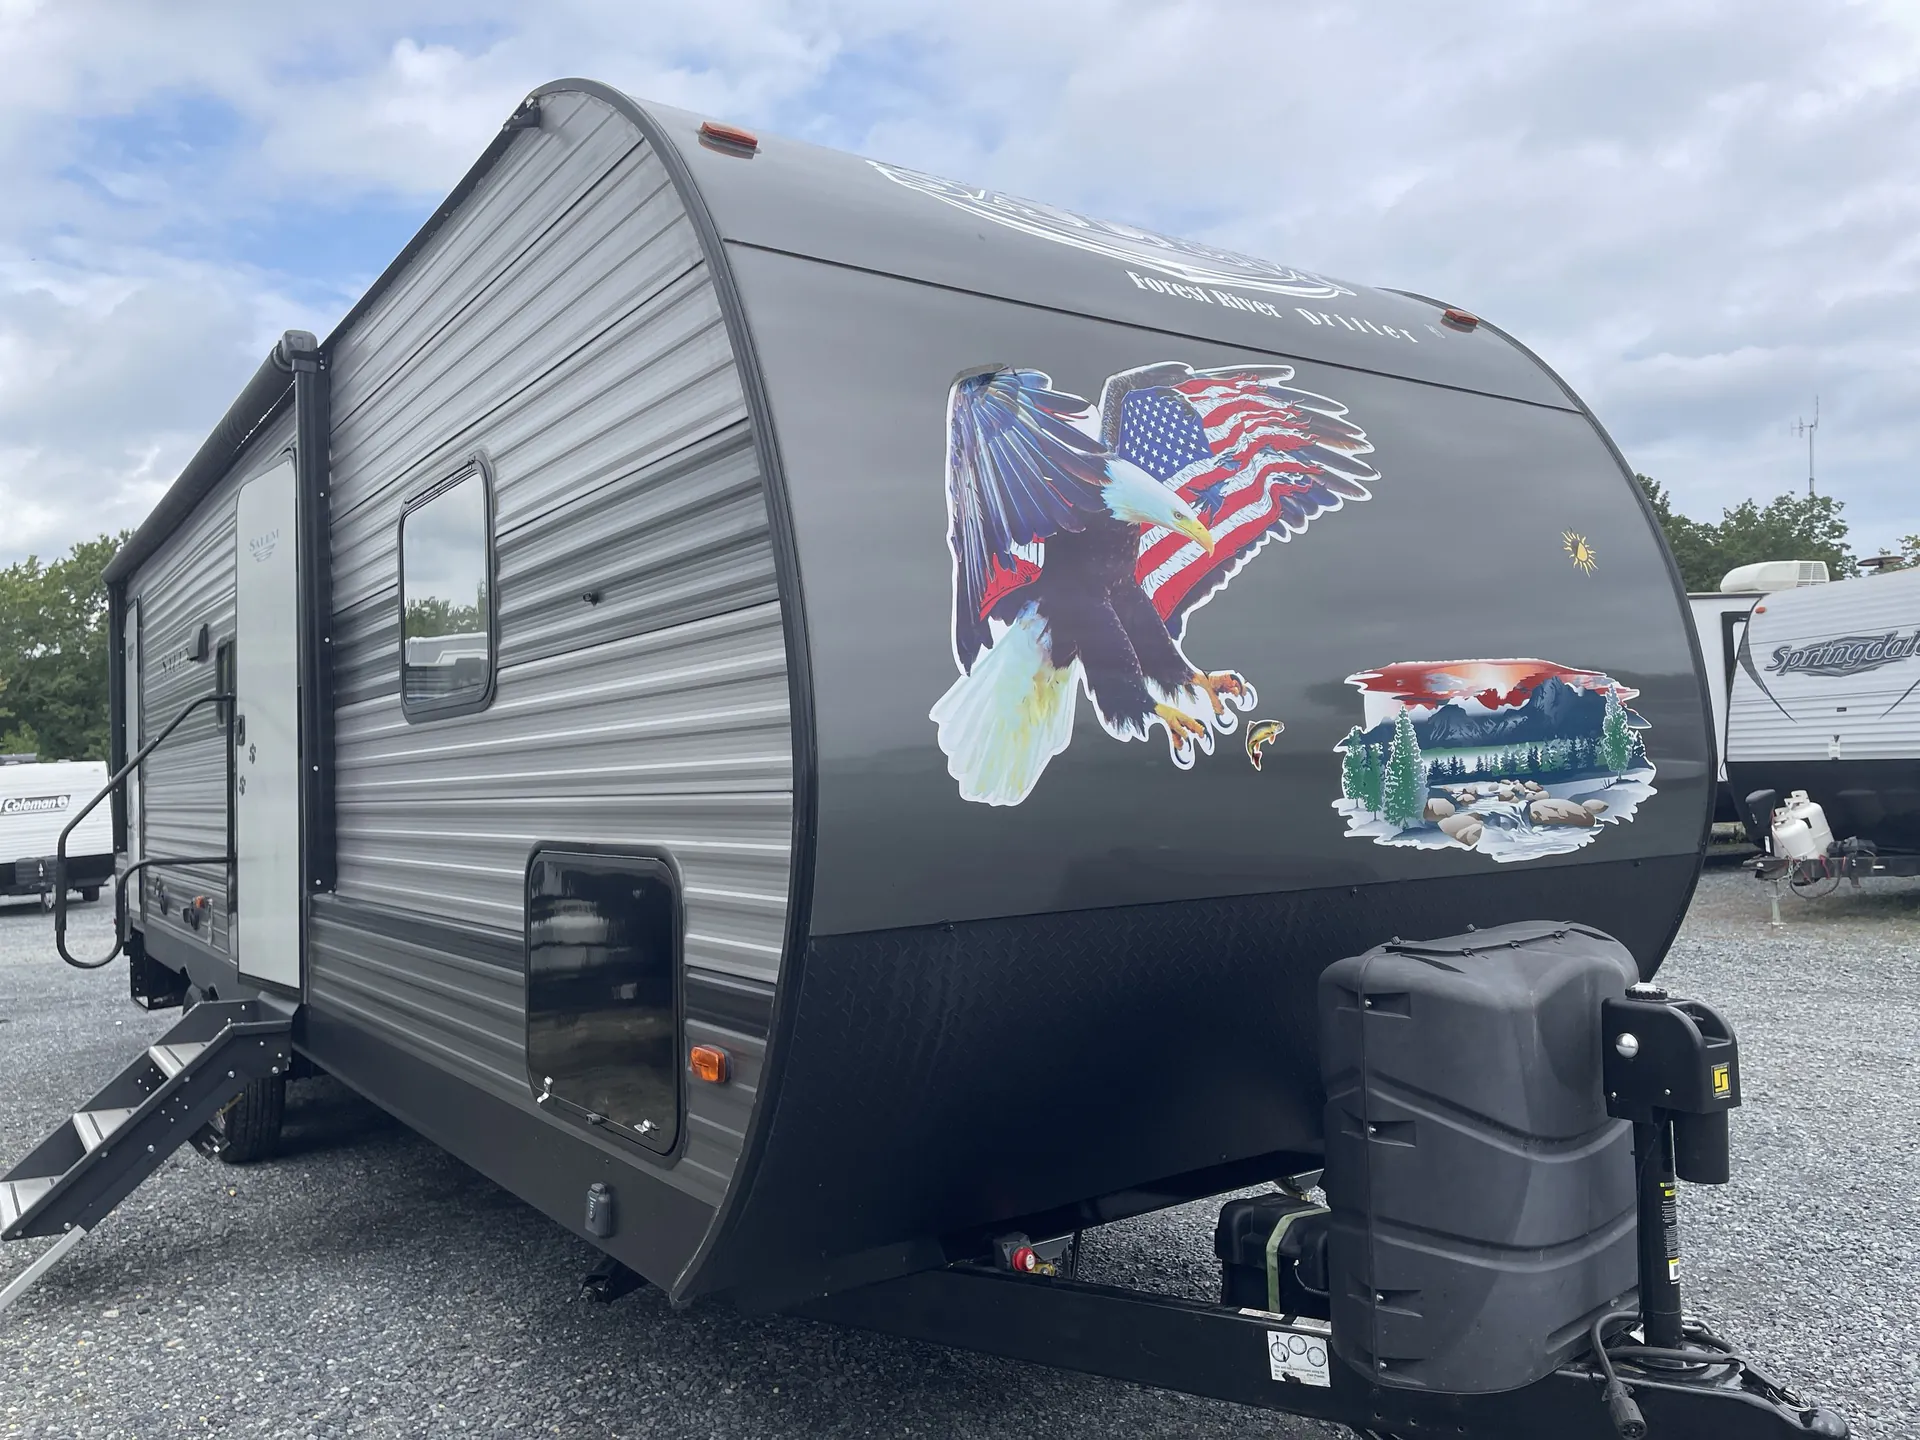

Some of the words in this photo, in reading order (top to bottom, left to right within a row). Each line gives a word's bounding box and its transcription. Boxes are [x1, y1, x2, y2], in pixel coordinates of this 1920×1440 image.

[1124, 269, 1214, 304] Forest
[1208, 289, 1283, 319] River
[1294, 307, 1419, 343] Drifter
[4, 798, 57, 813] Coleman
